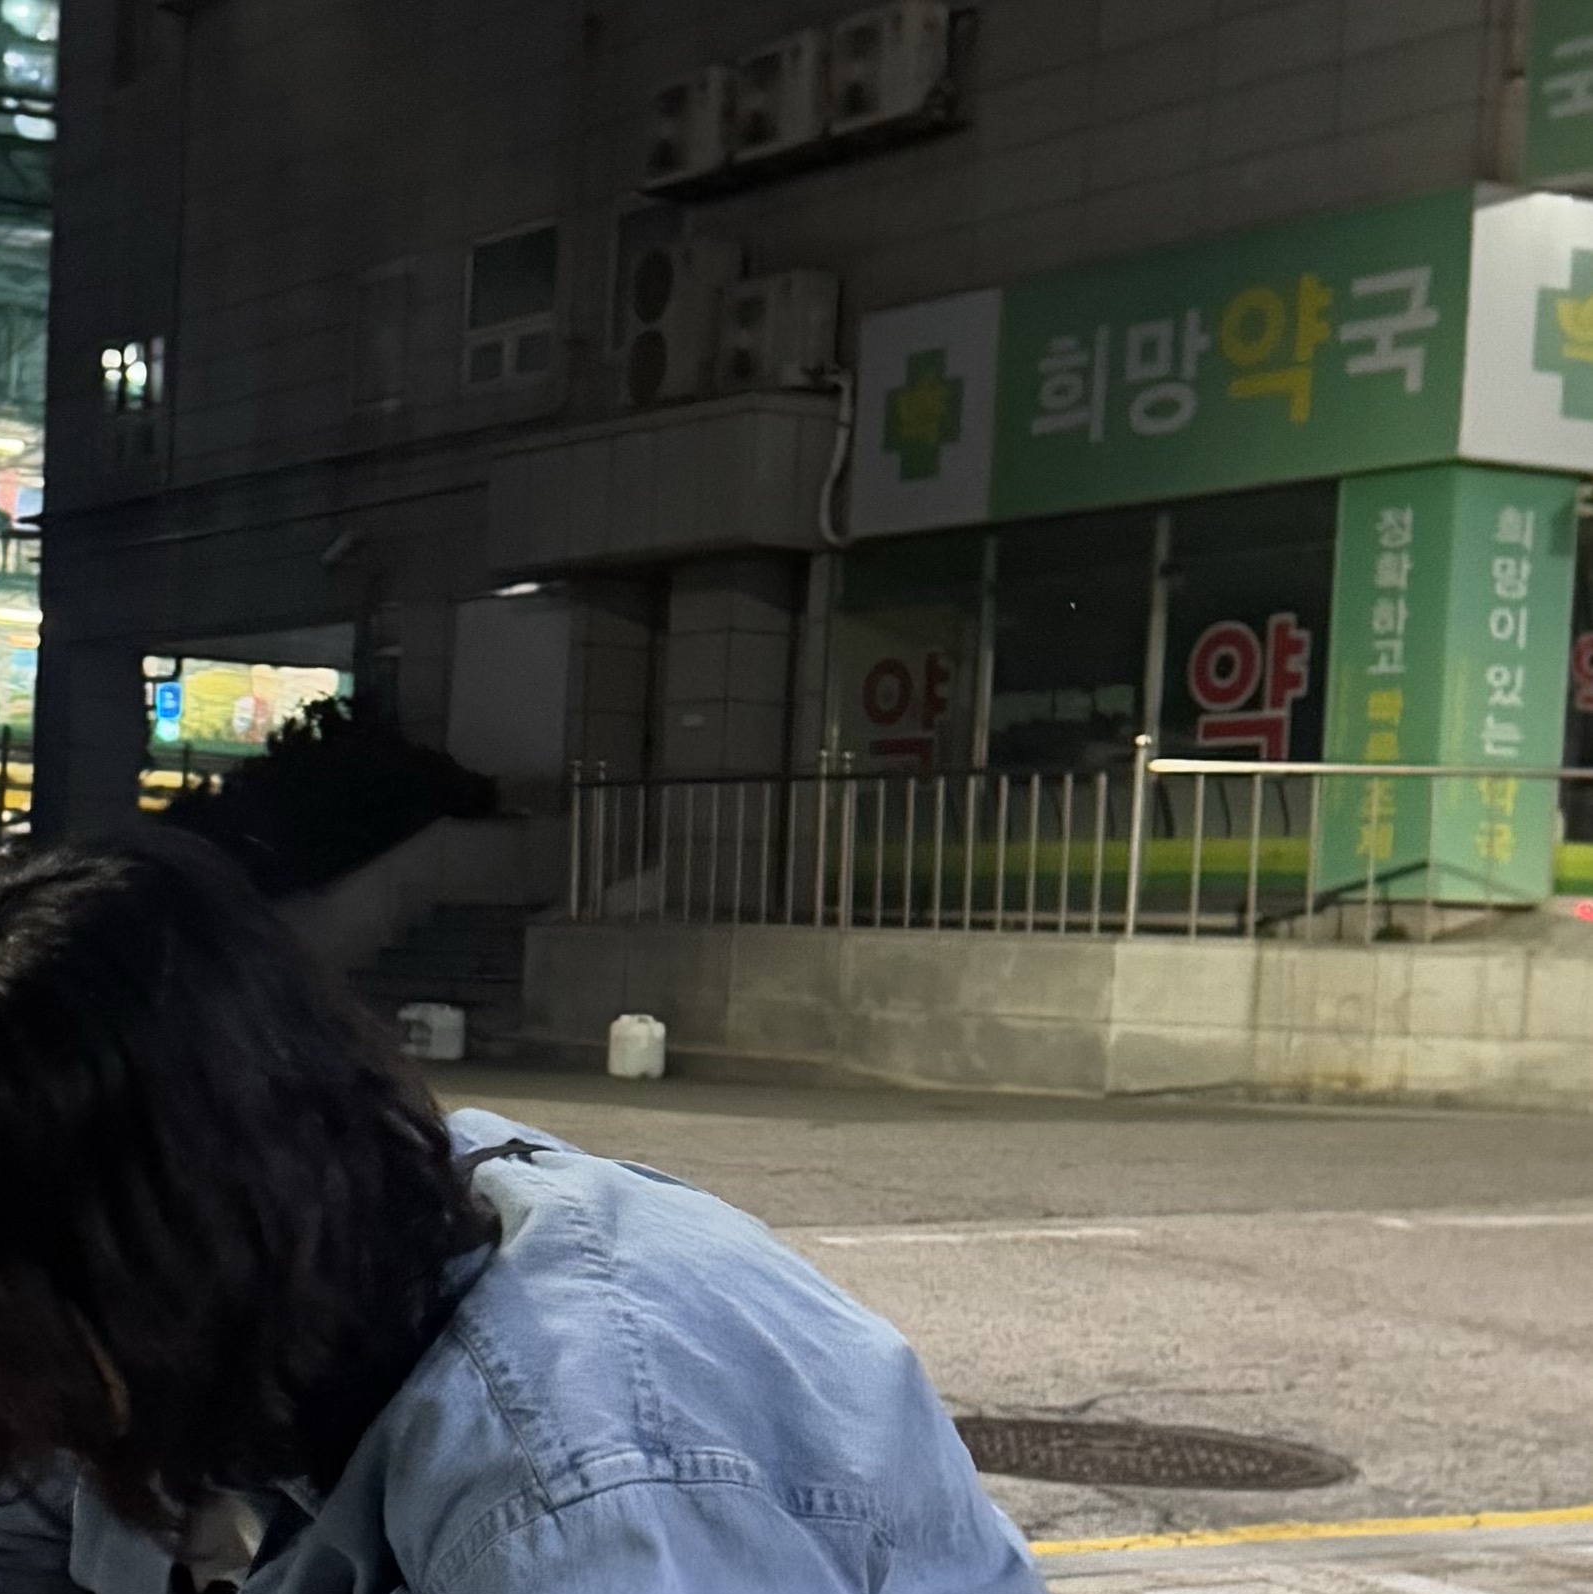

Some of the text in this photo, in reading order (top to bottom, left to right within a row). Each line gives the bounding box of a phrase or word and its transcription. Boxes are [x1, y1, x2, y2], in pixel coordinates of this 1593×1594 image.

[1030, 265, 1439, 443] 희망약국
[1489, 504, 1535, 650] 희망이
[862, 652, 953, 778] 약
[1187, 612, 1310, 763] 약
